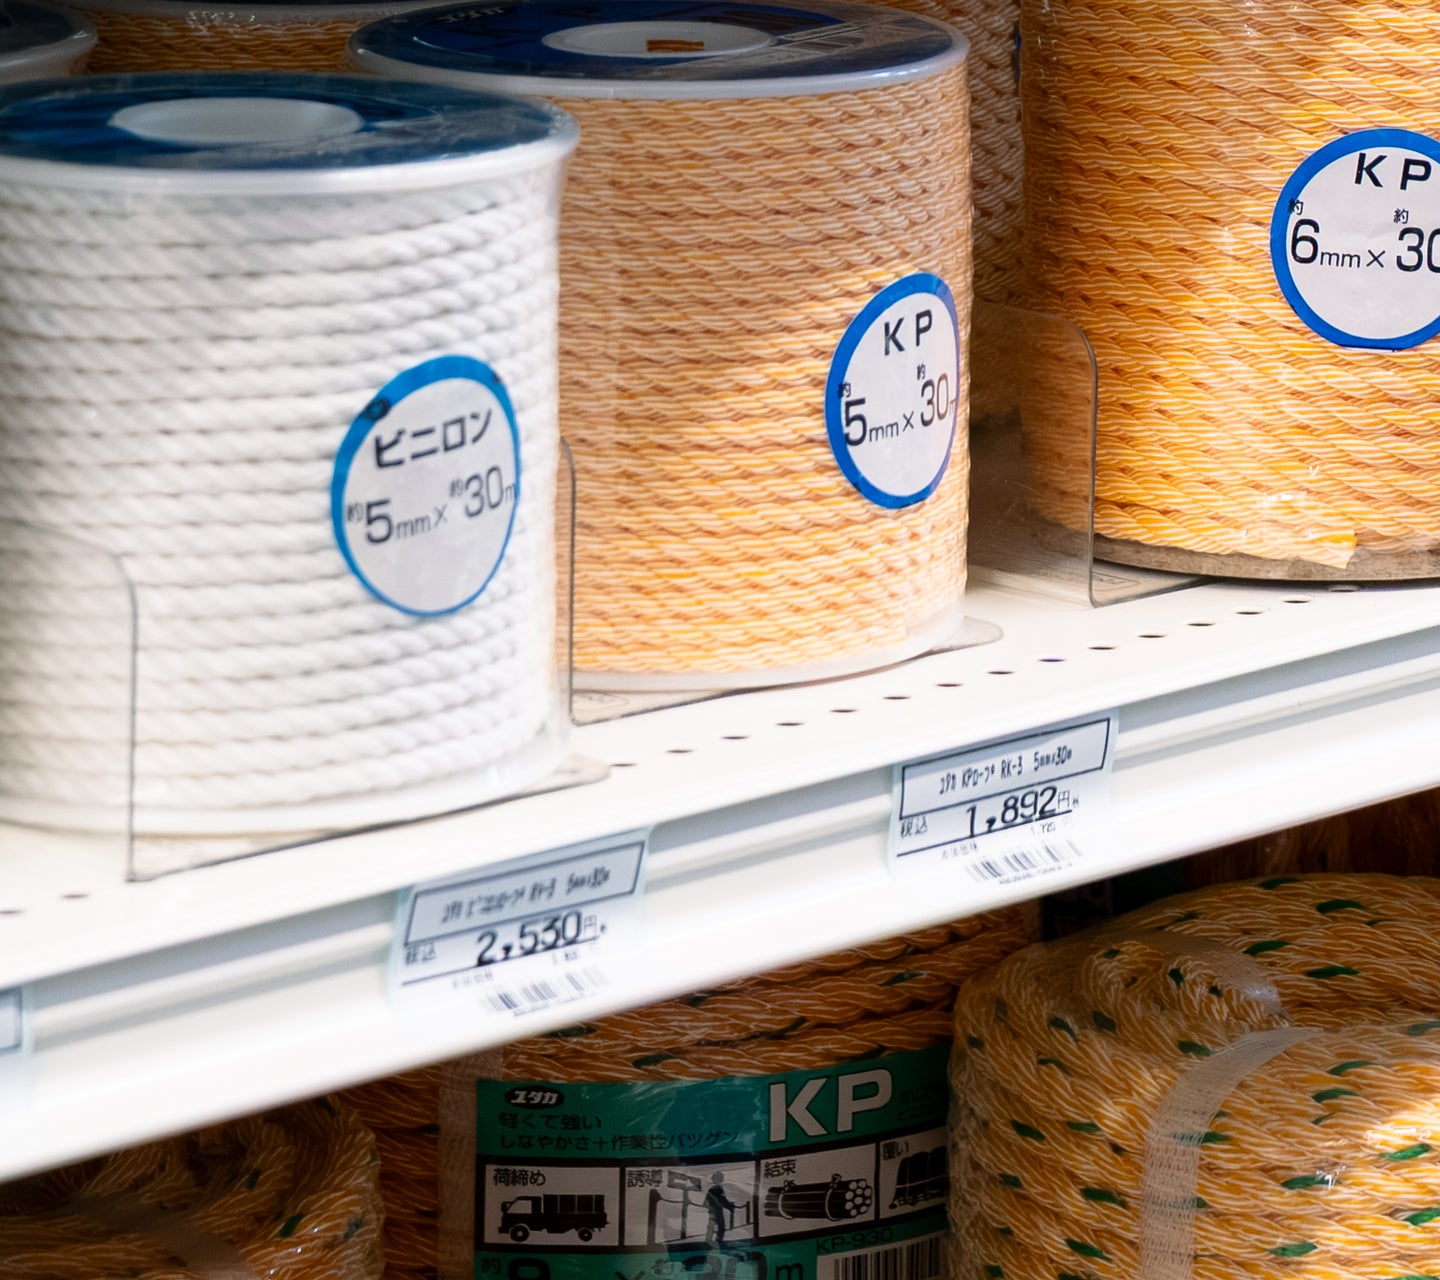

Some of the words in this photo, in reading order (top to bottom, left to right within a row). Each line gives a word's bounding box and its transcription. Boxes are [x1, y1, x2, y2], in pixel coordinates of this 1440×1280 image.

[374, 406, 494, 470] ビニロン
[768, 1067, 894, 1142] KP
[498, 1111, 603, 1132] 軽くて強い
[492, 1168, 547, 1188] 荷締め
[763, 1158, 798, 1180] 結束
